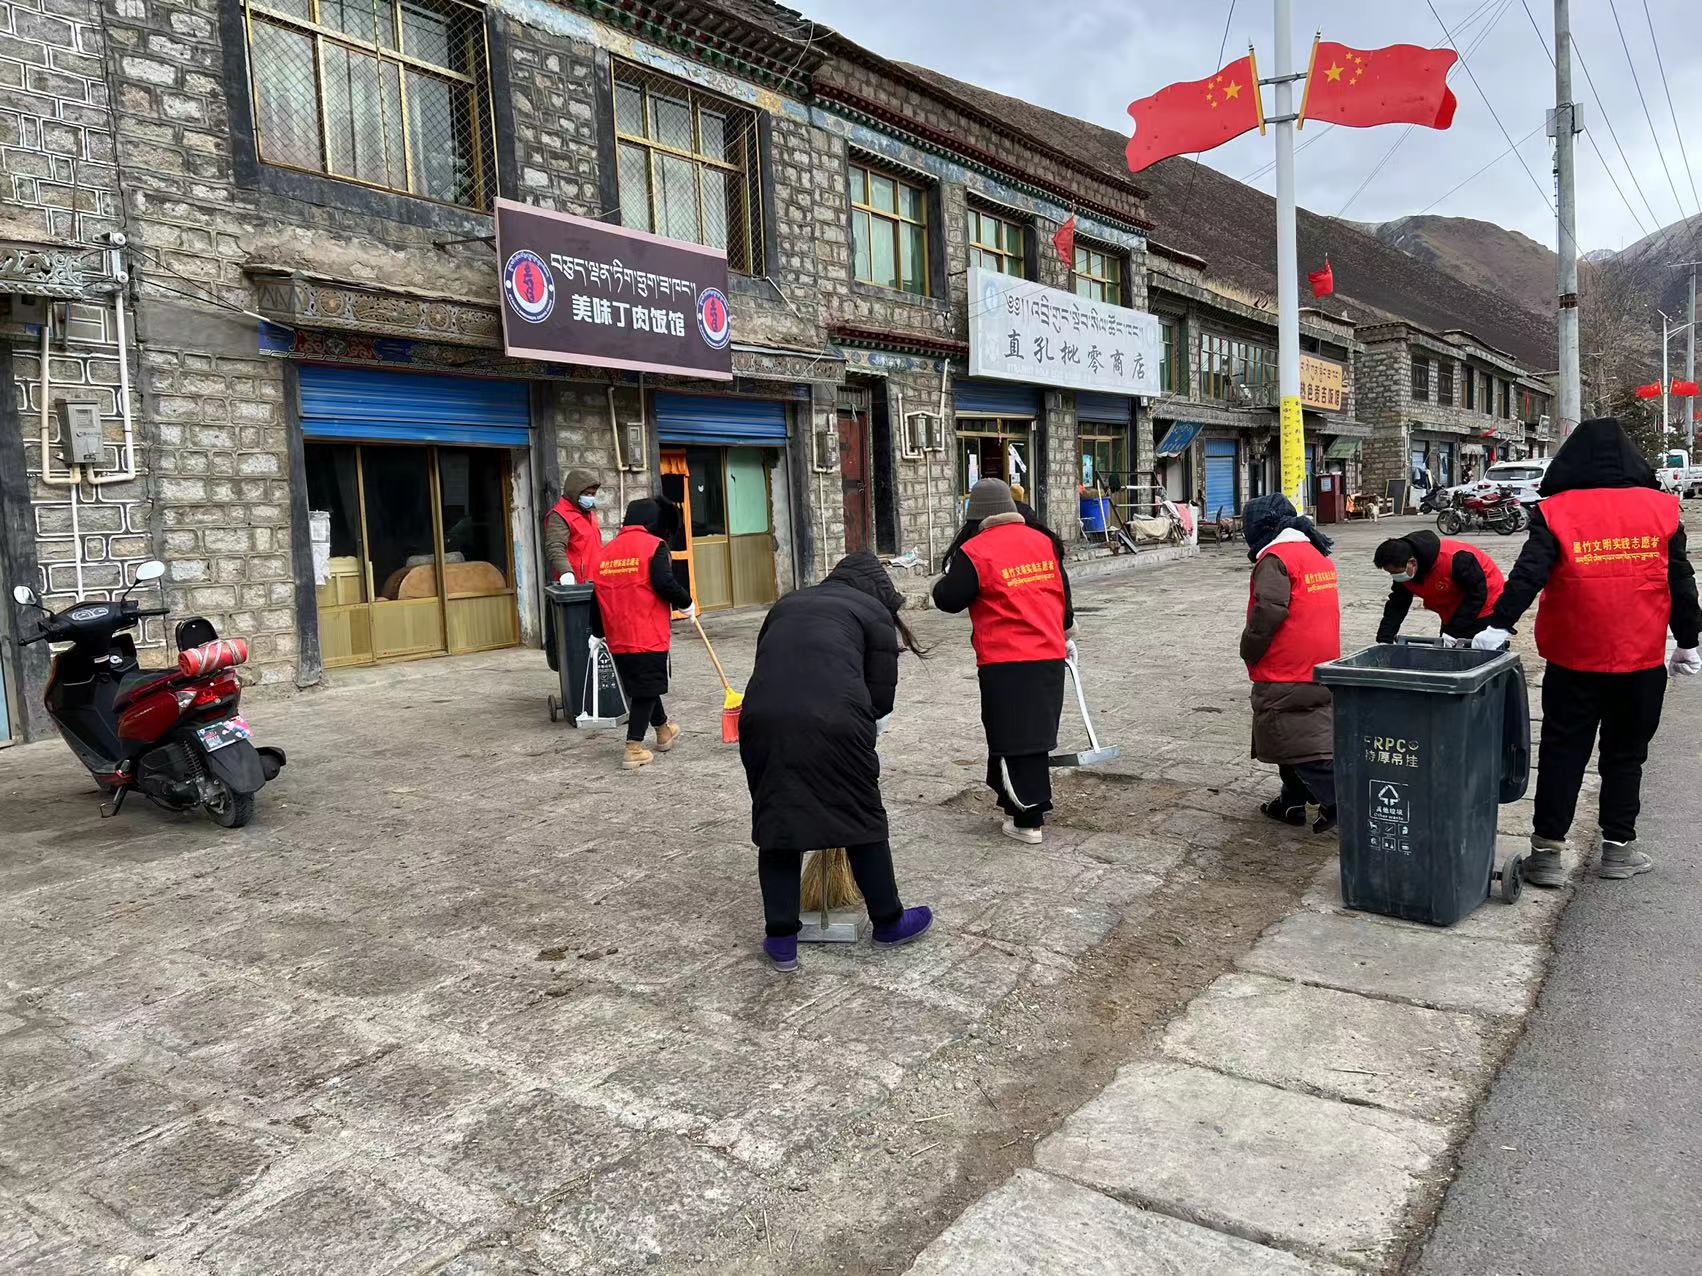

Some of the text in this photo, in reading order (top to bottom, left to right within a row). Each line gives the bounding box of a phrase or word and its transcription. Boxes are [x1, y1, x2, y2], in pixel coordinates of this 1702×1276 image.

[572, 293, 685, 337] 美味丁肉饭馆
[1004, 329, 1146, 380] 直孔批零商店
